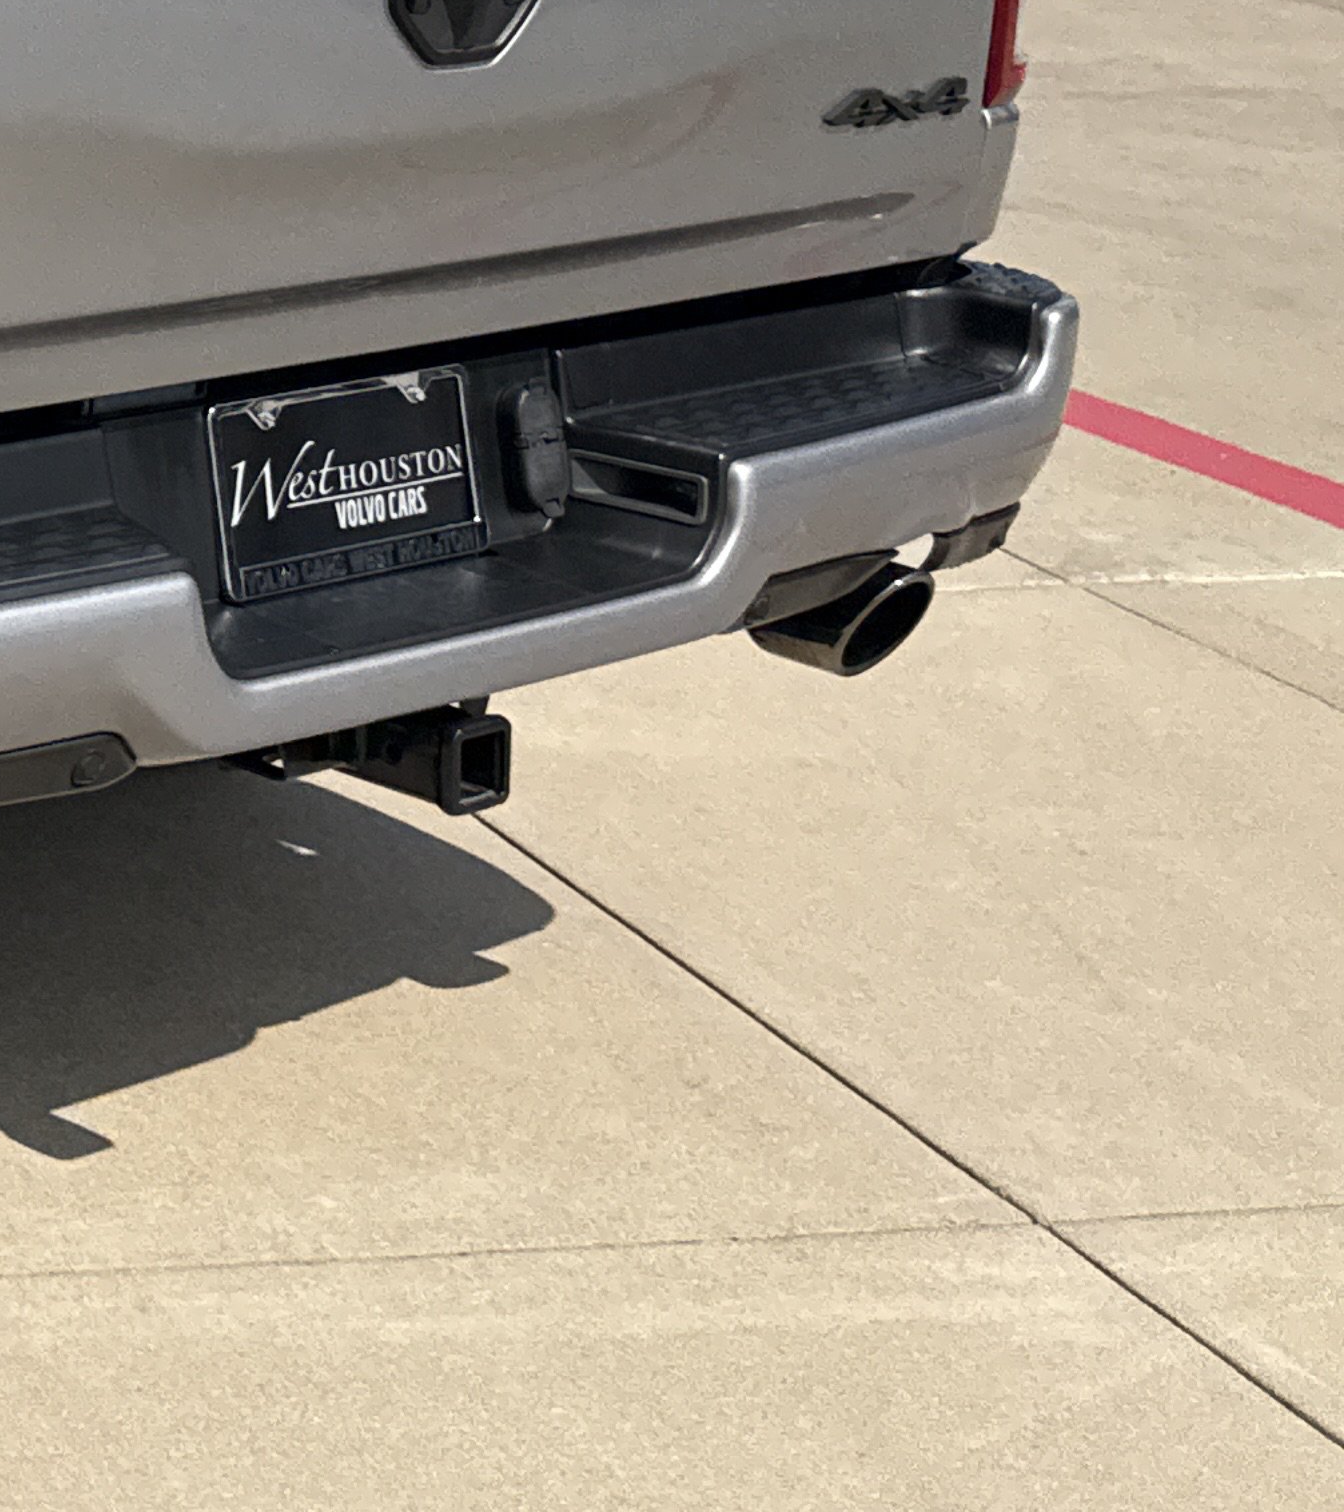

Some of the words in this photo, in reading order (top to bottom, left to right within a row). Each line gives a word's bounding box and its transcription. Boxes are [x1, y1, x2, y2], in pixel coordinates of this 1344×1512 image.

[230, 440, 336, 528] West
[338, 443, 463, 490] HOUSTON
[335, 496, 386, 530] VOLVO
[387, 486, 428, 520] CARS
